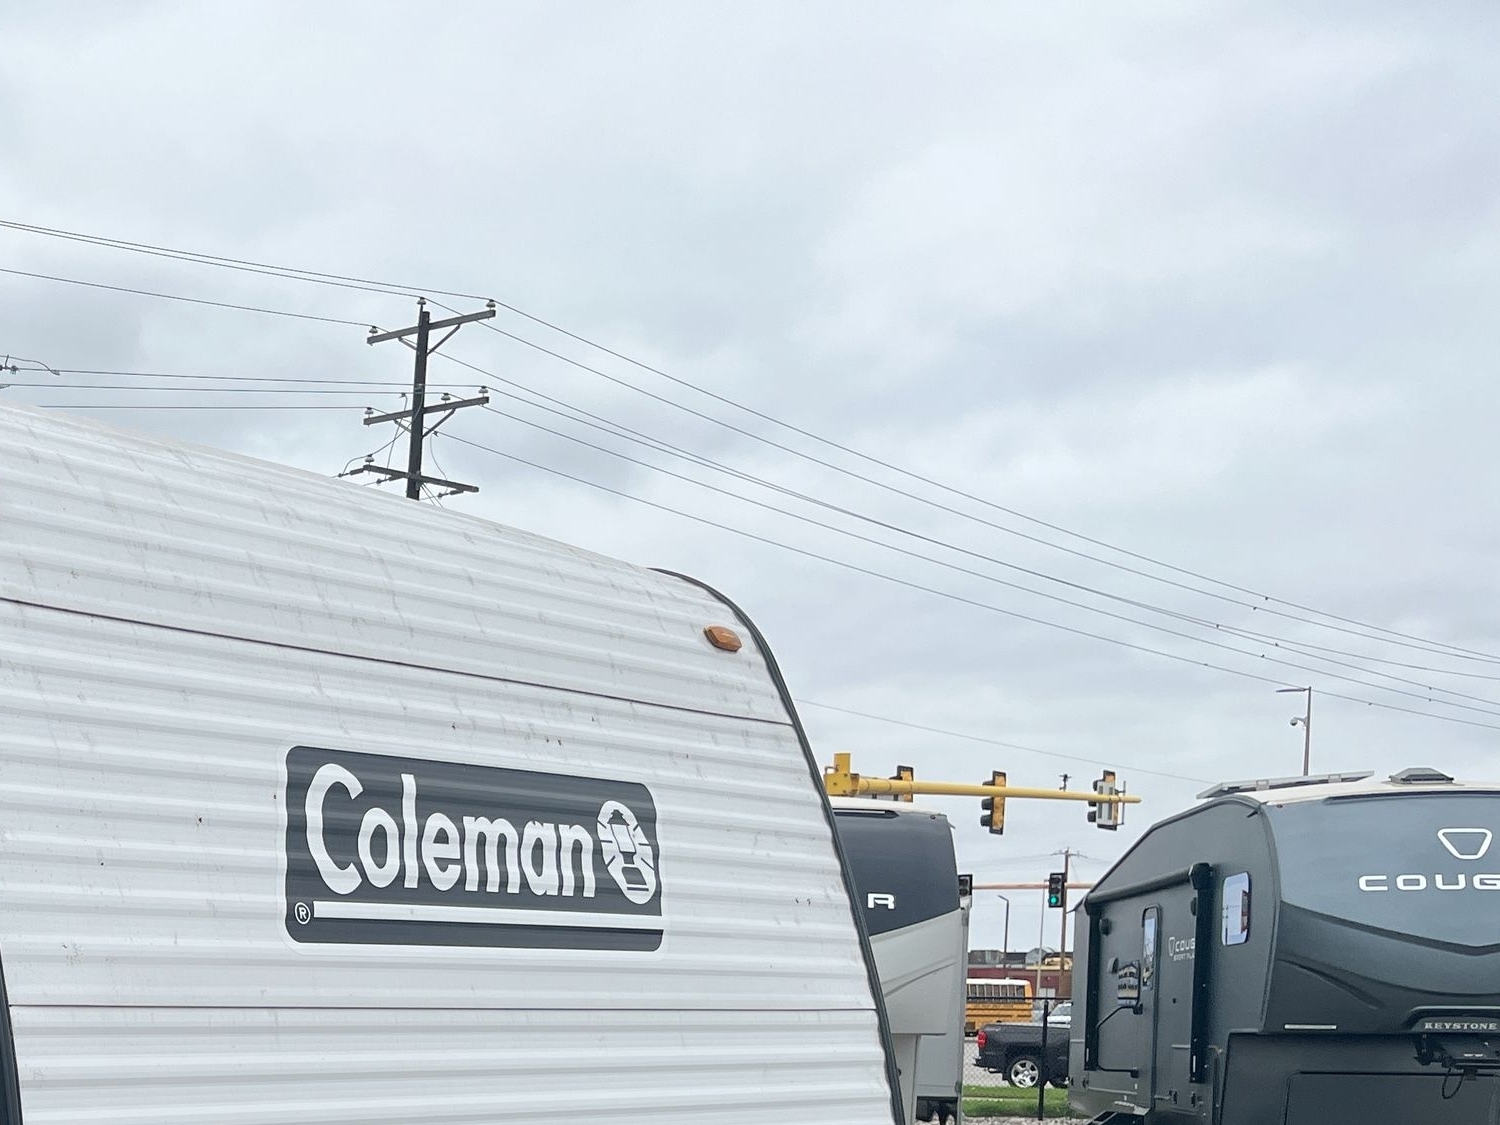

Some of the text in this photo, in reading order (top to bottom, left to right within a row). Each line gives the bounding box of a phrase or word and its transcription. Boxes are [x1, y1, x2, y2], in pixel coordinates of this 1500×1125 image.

[305, 763, 596, 898] Coleman
[1358, 873, 1500, 891] COUG
[1424, 1022, 1498, 1030] KEYSTONE
